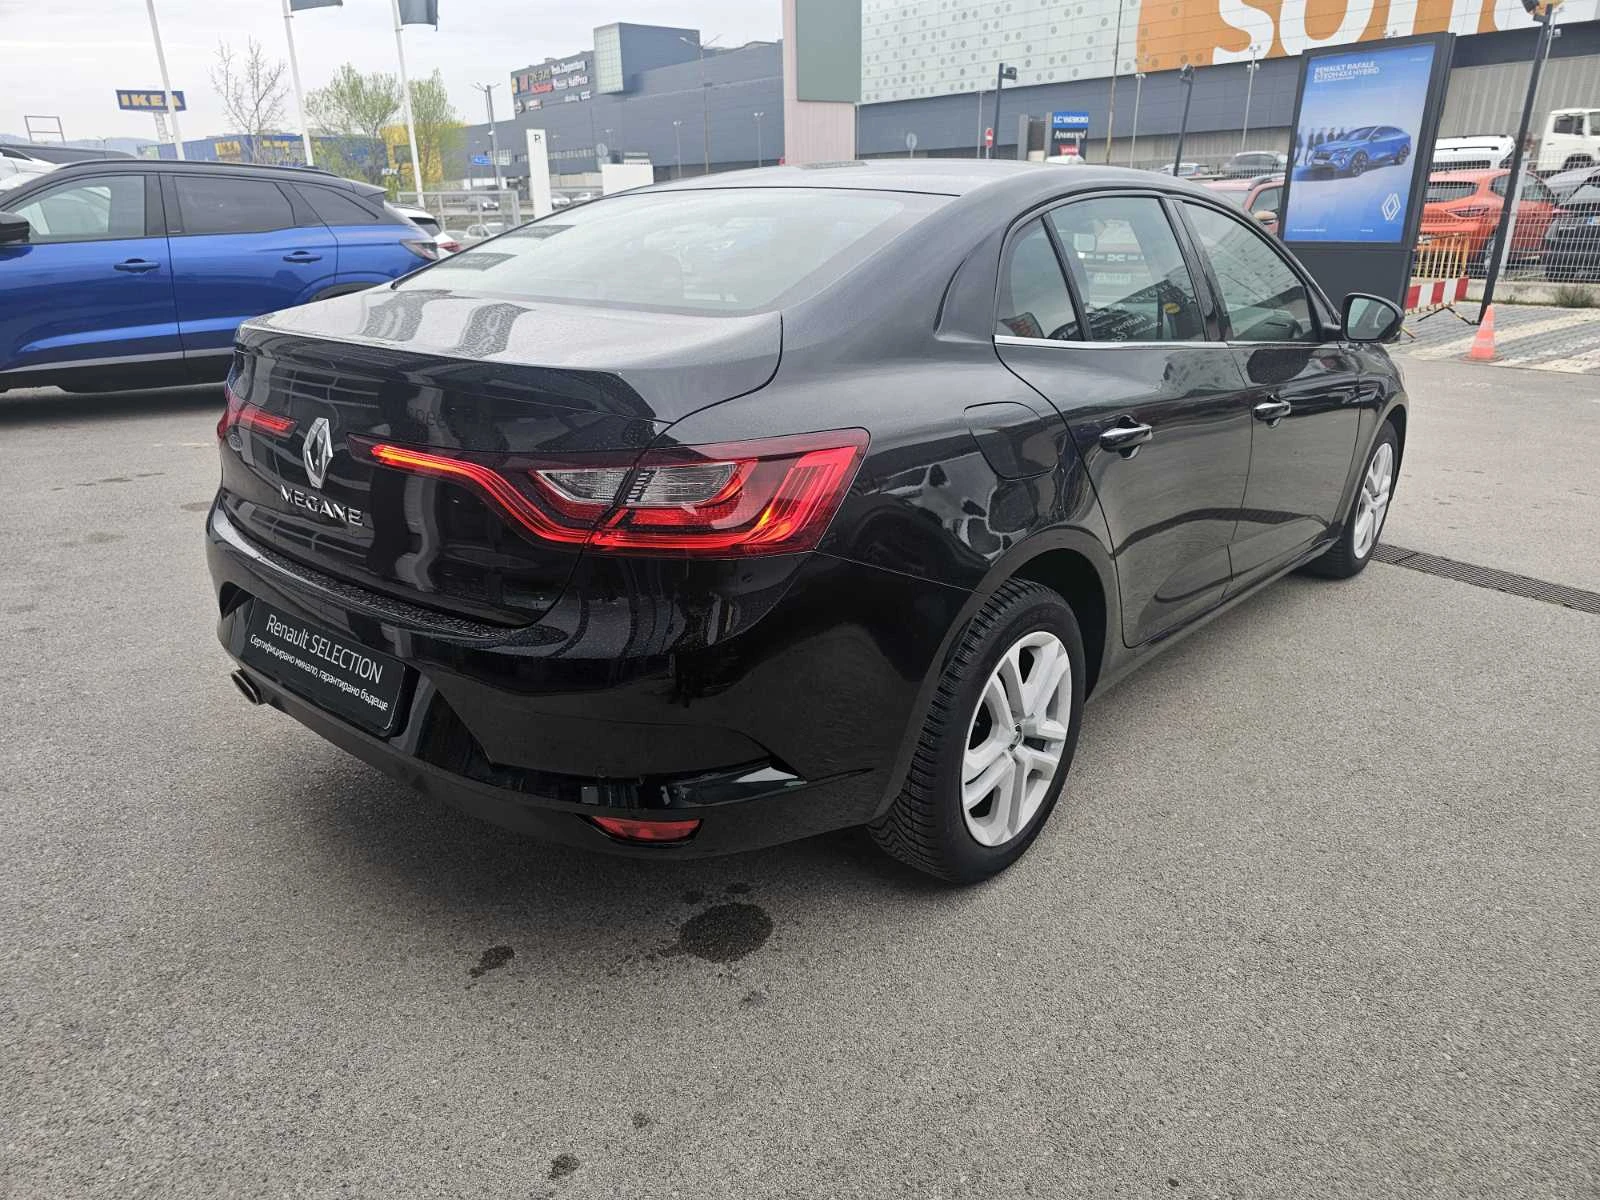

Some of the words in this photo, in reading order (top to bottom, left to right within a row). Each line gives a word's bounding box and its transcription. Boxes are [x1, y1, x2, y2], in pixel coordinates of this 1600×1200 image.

[280, 484, 363, 526] MEGANE
[250, 634, 296, 664] Сертифицирано
[295, 657, 319, 680] минало,
[318, 670, 360, 697] гарантирано
[360, 688, 388, 711] бъдеще
[266, 614, 310, 649] Renault
[309, 635, 384, 684] SELECTION
